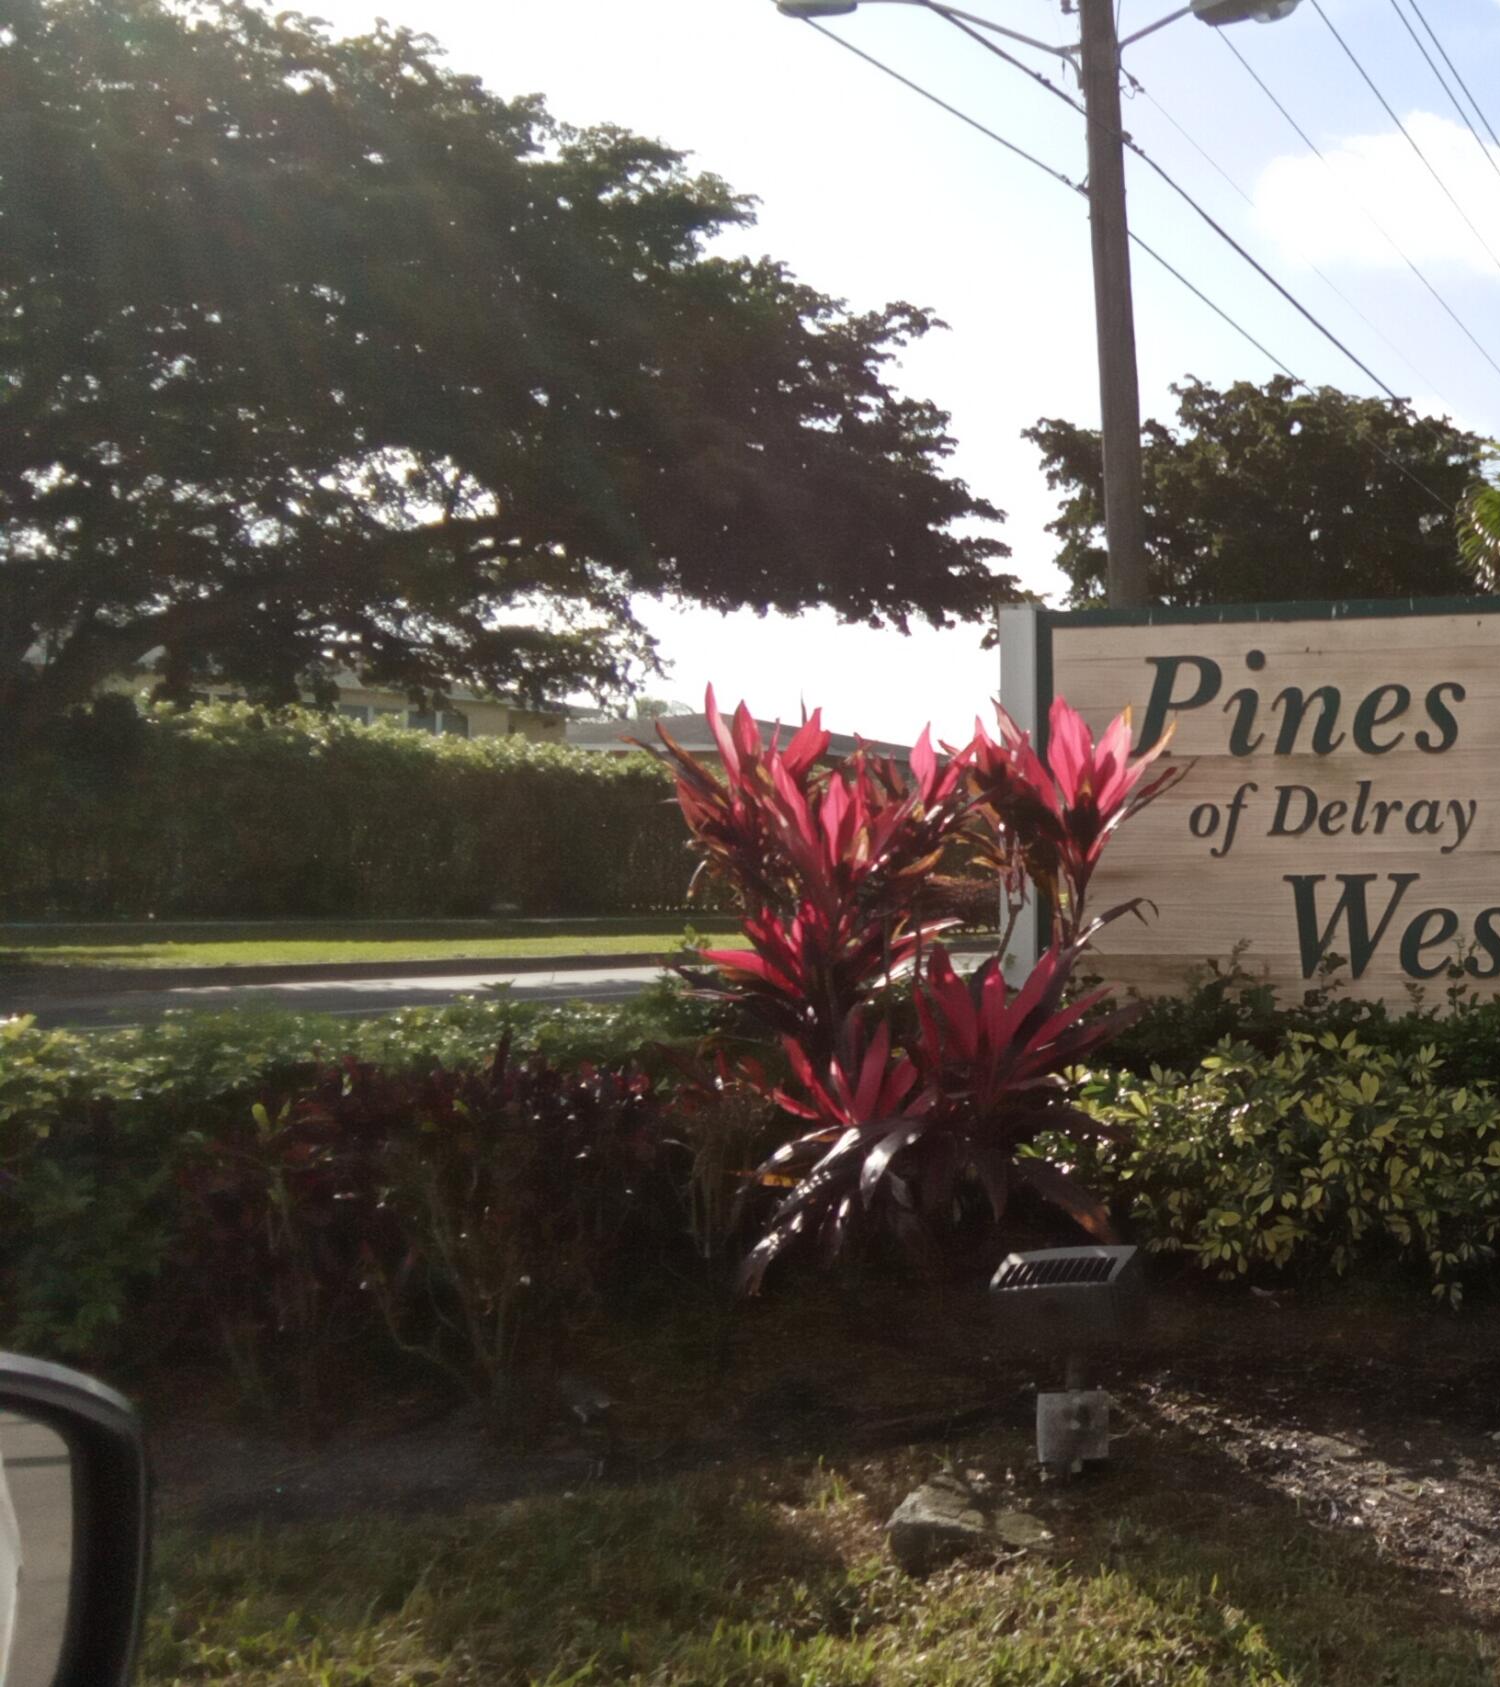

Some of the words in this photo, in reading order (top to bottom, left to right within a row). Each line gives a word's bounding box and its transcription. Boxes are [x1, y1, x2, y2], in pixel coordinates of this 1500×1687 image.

[1132, 649, 1467, 757] Pines
[1189, 782, 1259, 858] of
[1267, 780, 1478, 854] Delray
